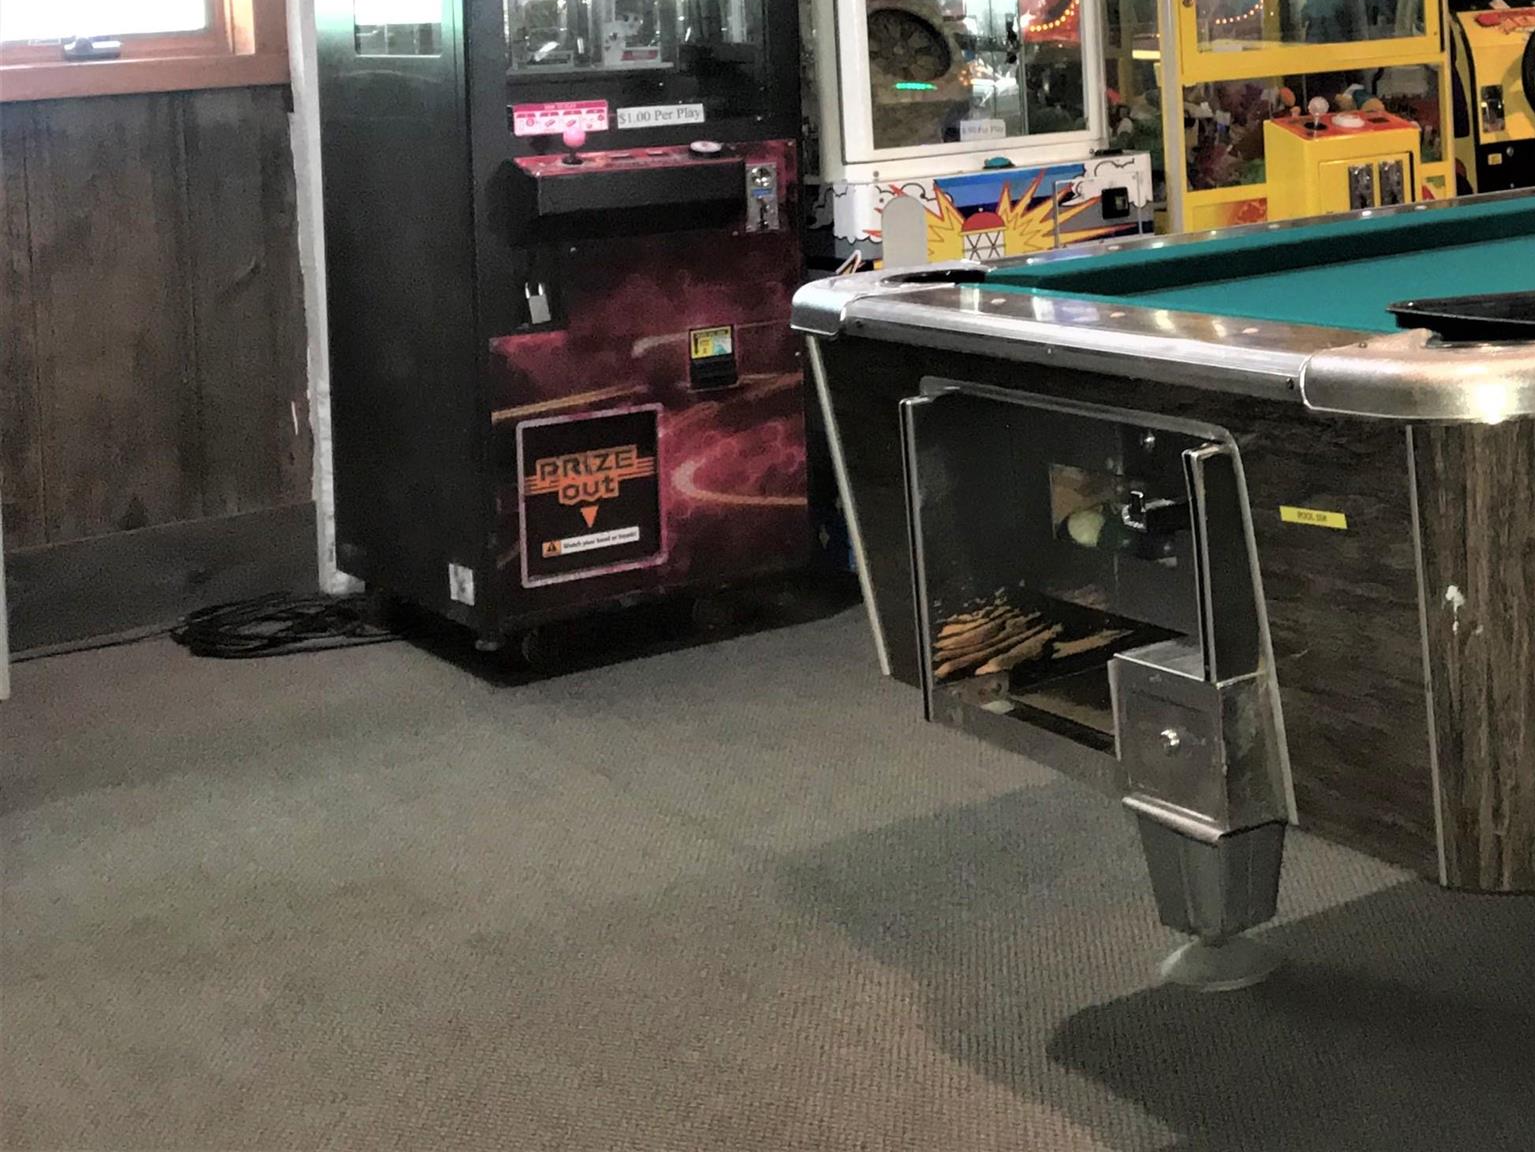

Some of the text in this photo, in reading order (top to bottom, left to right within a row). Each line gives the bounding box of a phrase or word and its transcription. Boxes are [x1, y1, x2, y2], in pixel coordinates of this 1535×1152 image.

[619, 110, 652, 125] $1.00
[654, 110, 674, 122] Per
[677, 107, 702, 122] Play
[540, 449, 635, 481] PRIZE
